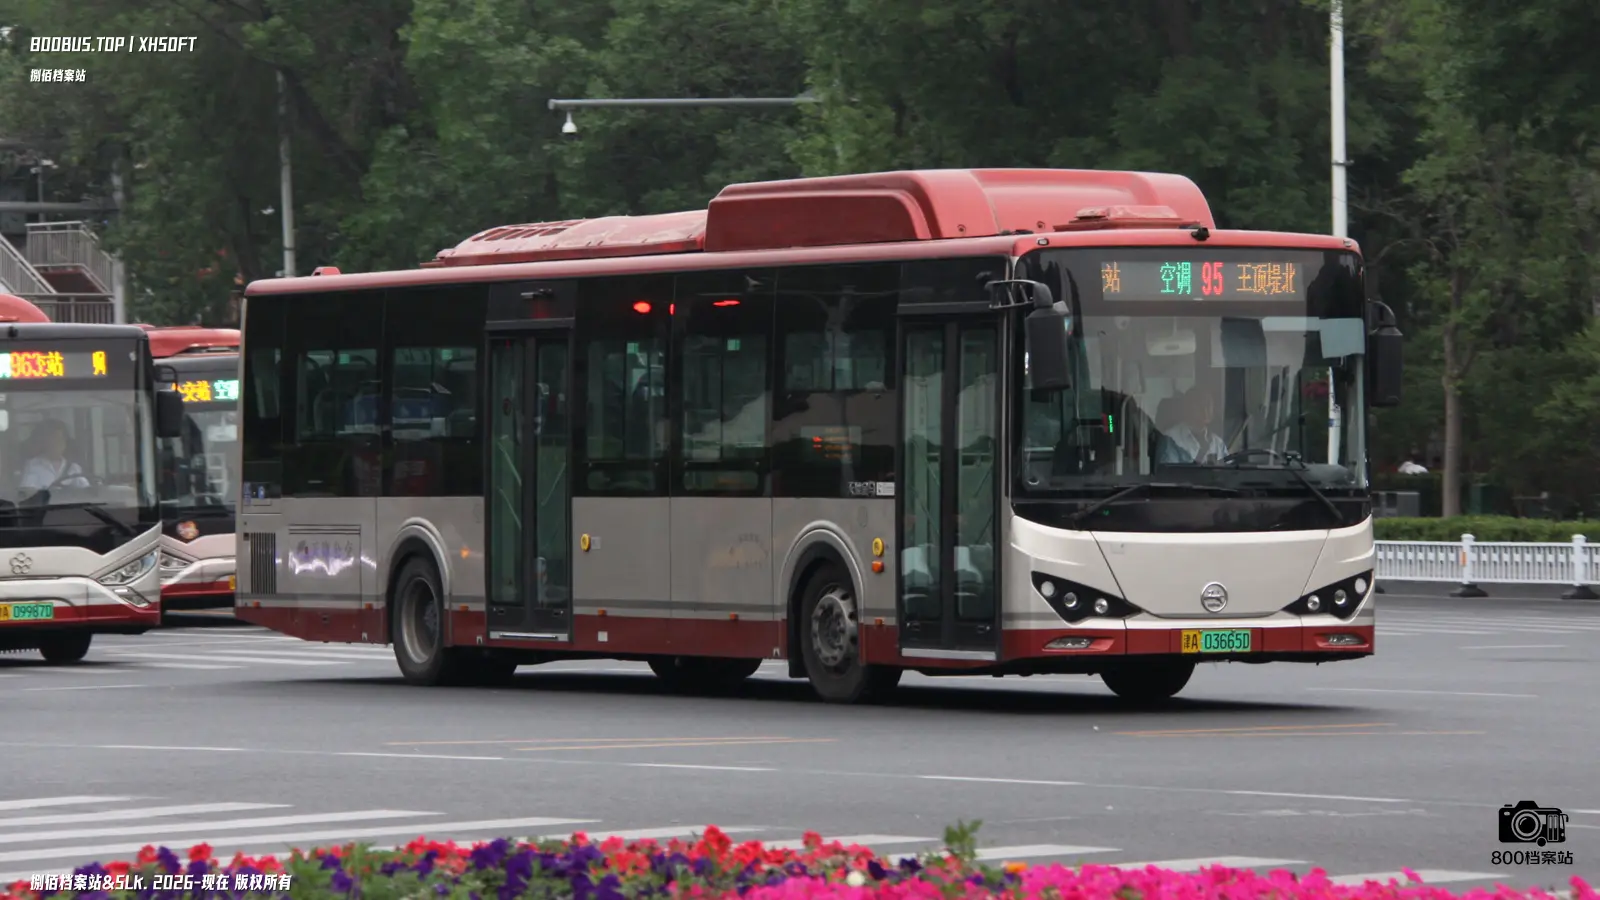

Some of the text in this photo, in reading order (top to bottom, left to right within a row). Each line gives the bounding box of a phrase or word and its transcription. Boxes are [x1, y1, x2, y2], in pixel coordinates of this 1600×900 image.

[1101, 261, 1296, 296] 站 空调 95 王顶堤北
[13, 604, 52, 618] 09987D
[1204, 632, 1250, 650] 03665D
